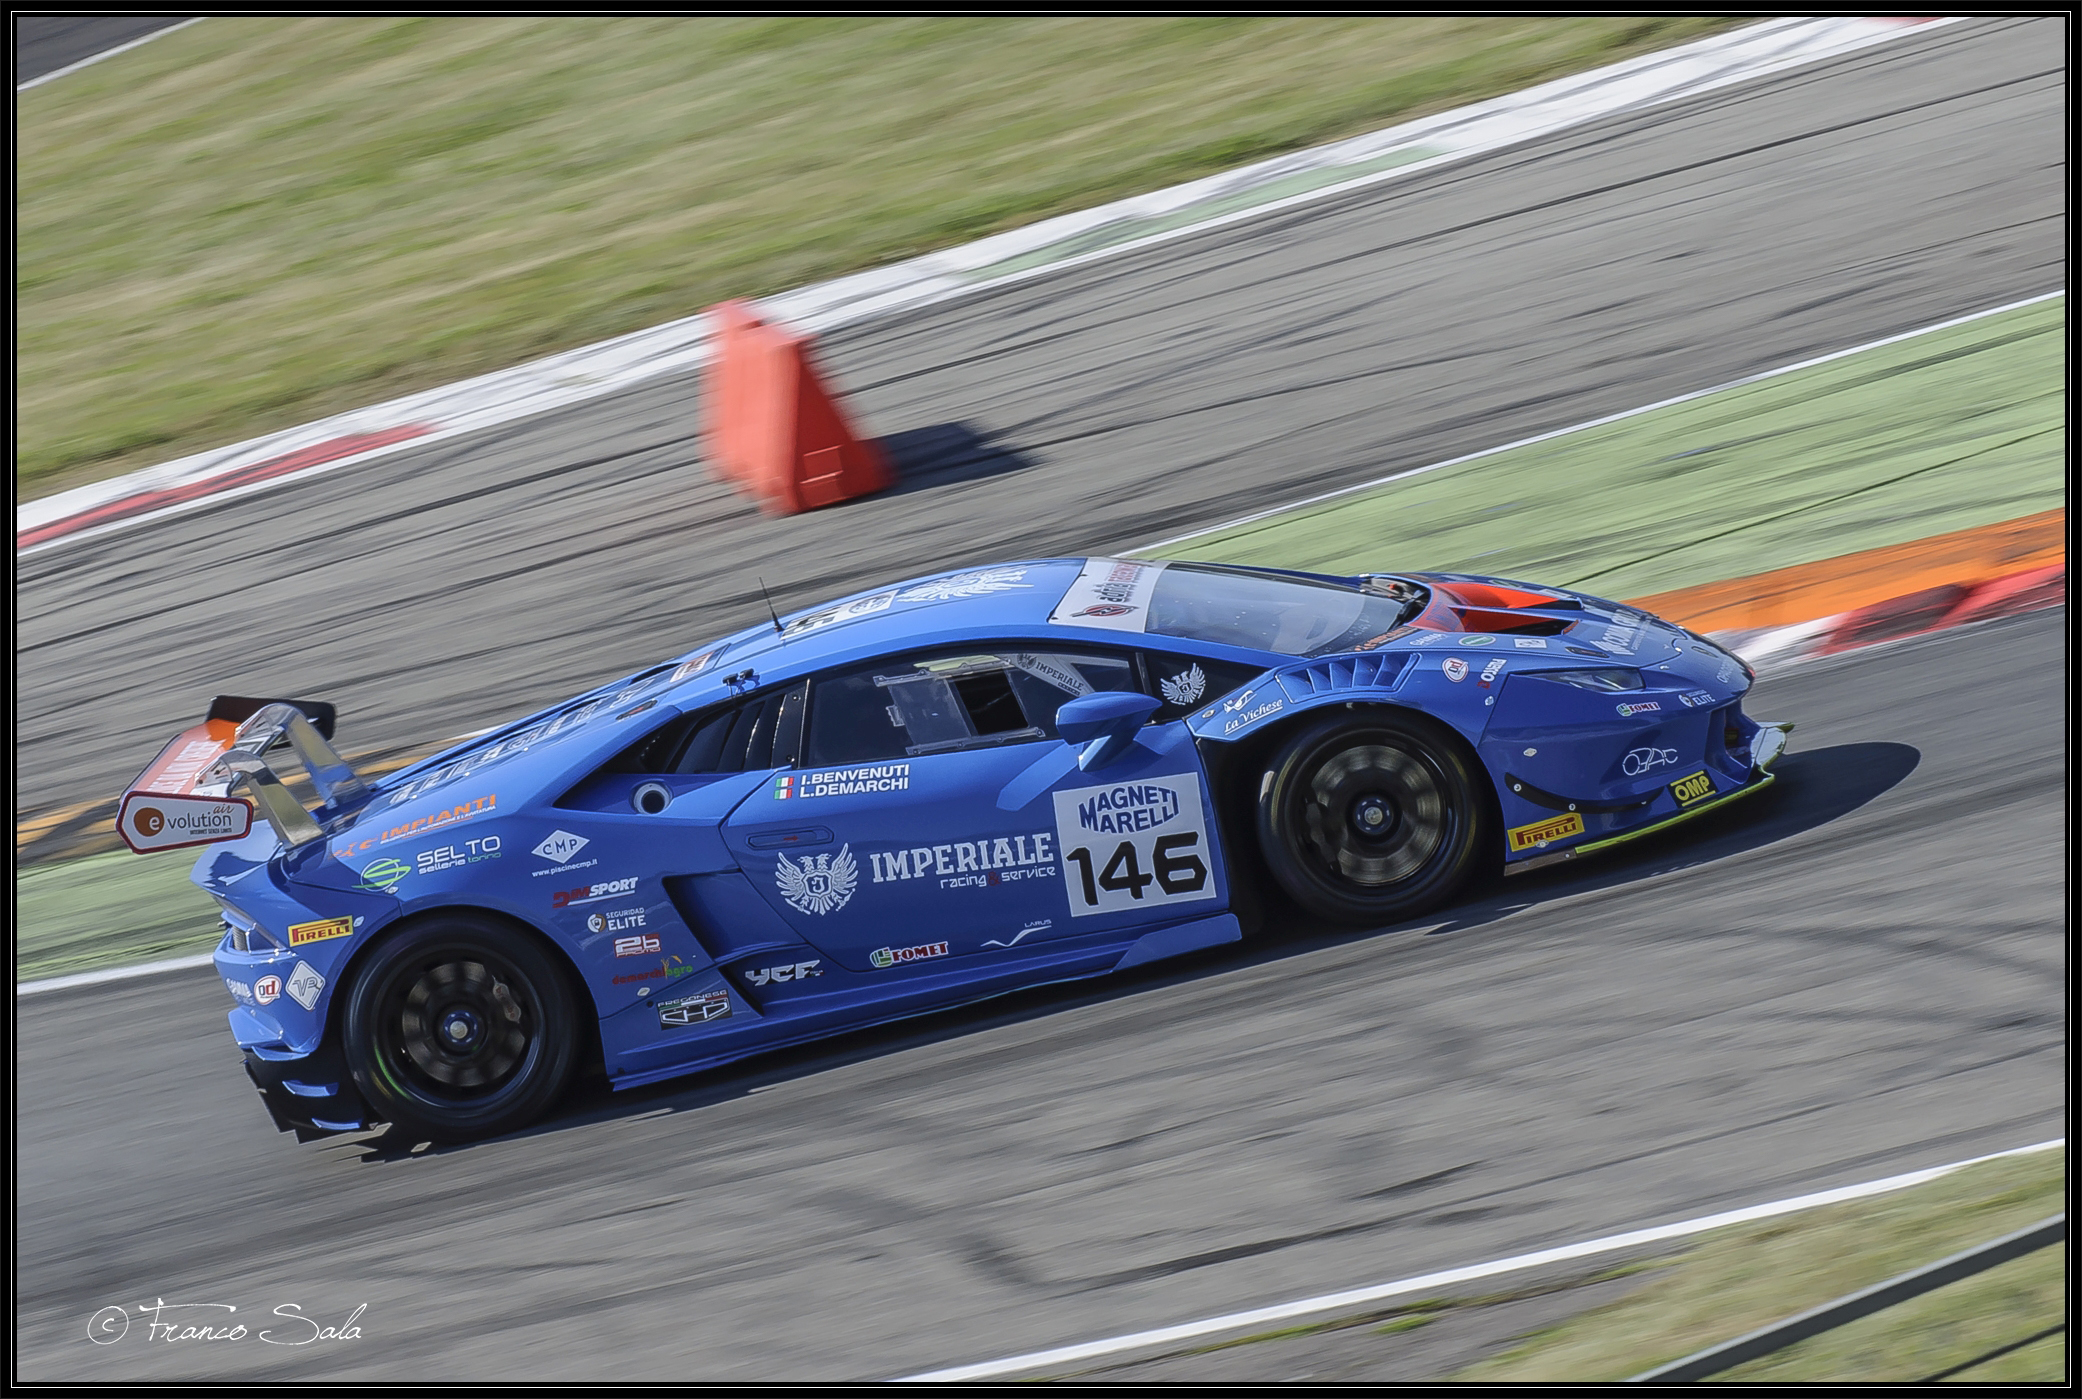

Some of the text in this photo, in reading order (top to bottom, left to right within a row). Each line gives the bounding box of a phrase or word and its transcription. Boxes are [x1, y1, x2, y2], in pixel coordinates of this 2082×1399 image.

[1036, 662, 1084, 691] IMPERIALE
[1629, 702, 1661, 713] FOMET
[1692, 694, 1716, 706] ELITE
[1224, 699, 1283, 733] La Vichese
[801, 764, 909, 786] I.BENVENUTI
[800, 777, 909, 798] L.DEMARCHI
[1674, 775, 1710, 801] OMP
[213, 804, 234, 814] air
[1078, 785, 1180, 820] MAGNETI
[381, 794, 496, 841] IMPIANTI
[1079, 800, 1179, 834] MARELLI
[1515, 816, 1577, 846] PIRELLI
[542, 838, 578, 855] CMP
[870, 833, 1054, 883] IMPERIALE
[418, 851, 501, 875] sellerie torino
[531, 858, 598, 877] www.piscinecmp.it
[1066, 831, 1208, 907] 146
[940, 873, 987, 889] racing
[1001, 866, 1056, 882] service
[606, 907, 645, 919] SEGURIDAD
[608, 915, 647, 931] ELITE
[1024, 919, 1052, 928] LARUS
[292, 919, 350, 943] PIRELLI
[892, 941, 949, 962] FOMET
